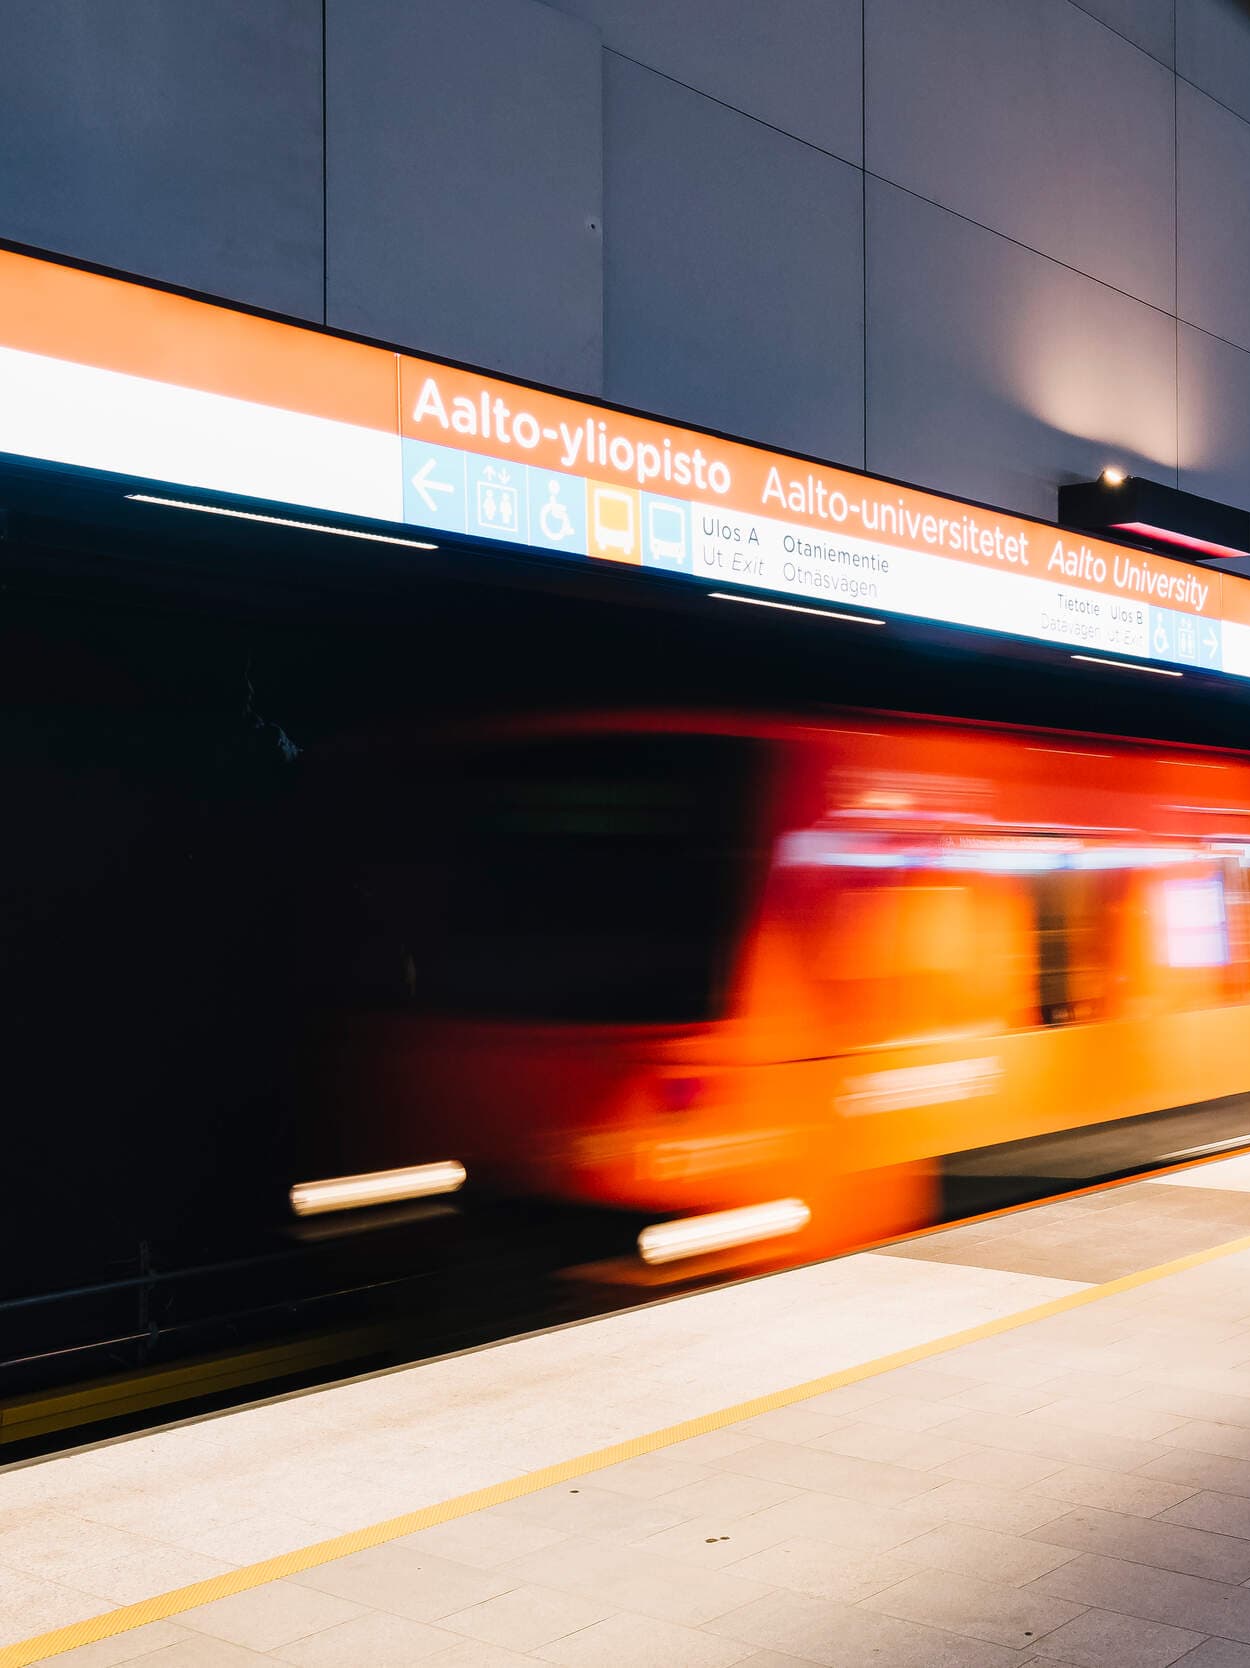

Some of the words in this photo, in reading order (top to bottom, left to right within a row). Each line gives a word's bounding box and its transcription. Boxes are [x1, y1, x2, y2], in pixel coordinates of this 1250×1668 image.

[413, 378, 732, 494] Aalto-yliopisto
[762, 466, 1030, 567] Aalto-universitetet
[1047, 540, 1107, 583] Aalto
[1113, 555, 1209, 612] University
[702, 516, 741, 542] Ulos
[748, 527, 760, 546] A
[783, 534, 889, 573] Otaniementie
[703, 543, 723, 568] Ut
[731, 552, 765, 576] Exit
[1057, 593, 1100, 616] Tietotie
[1110, 605, 1133, 623] Ulos
[1136, 610, 1144, 625] B
